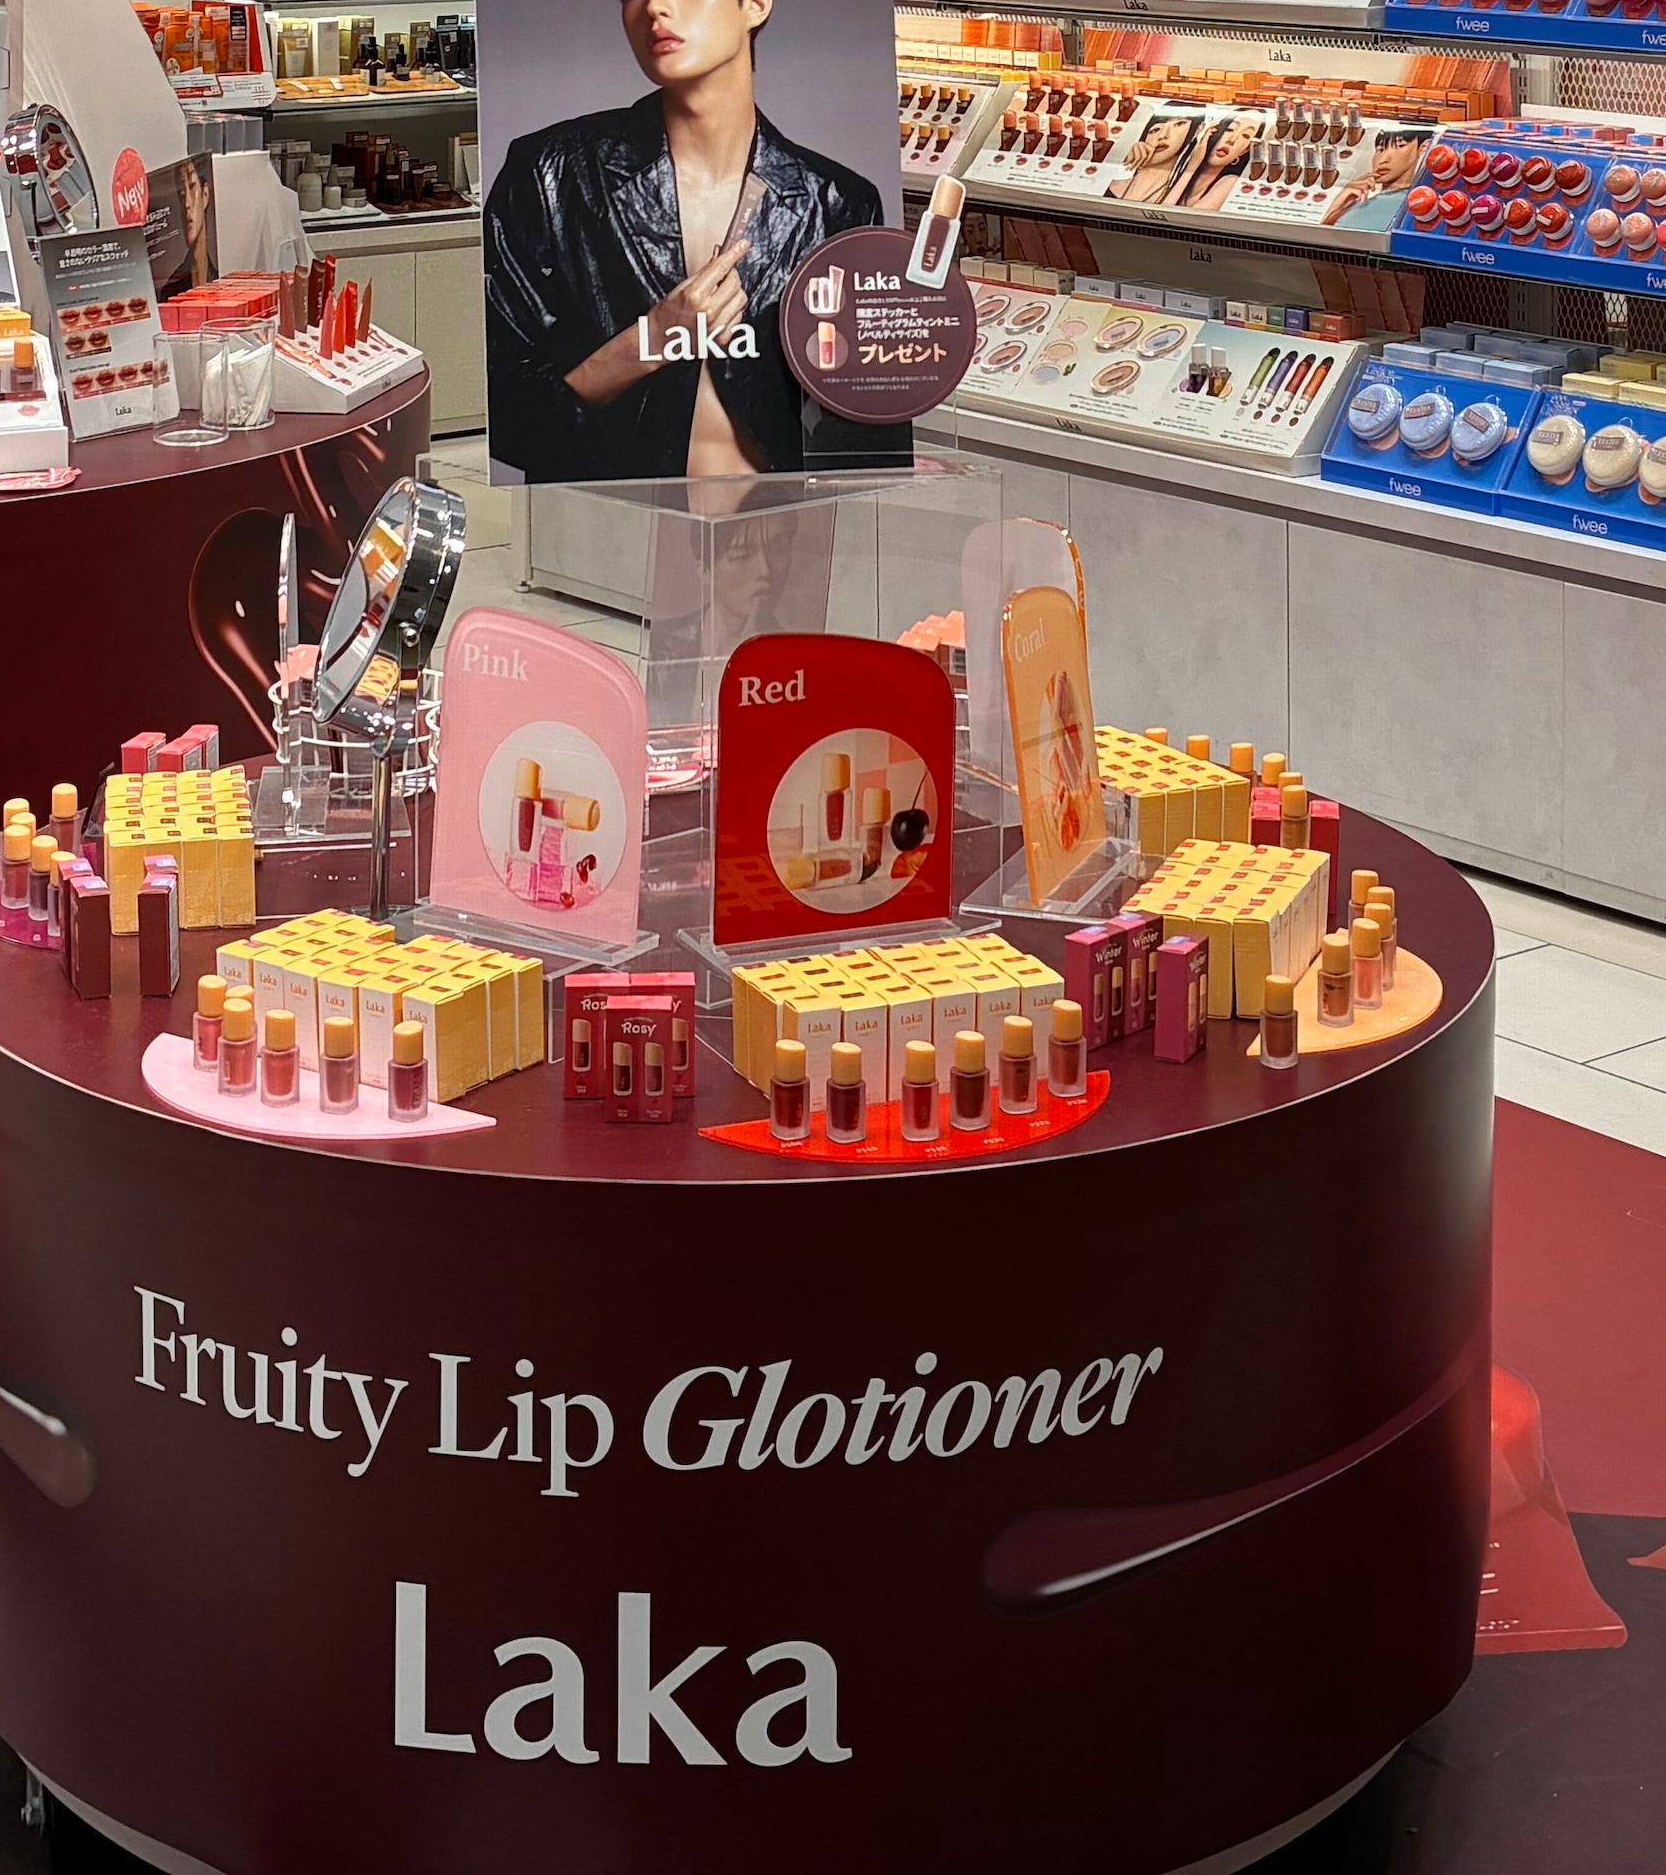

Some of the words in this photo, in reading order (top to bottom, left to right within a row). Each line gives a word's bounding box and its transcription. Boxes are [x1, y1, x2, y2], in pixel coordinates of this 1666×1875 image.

[1456, 17, 1491, 34] fwee
[1268, 49, 1291, 62] Laka
[117, 177, 145, 219] New
[1190, 248, 1212, 262] Laka
[1461, 248, 1495, 266] fwee
[854, 271, 901, 291] Laka
[636, 311, 759, 363] Laka
[858, 343, 947, 365] プレゼント
[1389, 476, 1422, 497] fwee
[1572, 515, 1608, 535] fwee
[1013, 621, 1047, 664] Coral
[461, 643, 529, 683] Pink
[737, 669, 806, 707] Red
[1133, 930, 1160, 949] Winter
[1095, 945, 1123, 965] Winter
[581, 998, 607, 1012] Ros
[621, 1022, 656, 1038] Rosy
[133, 1285, 408, 1477] Fruity
[428, 1351, 614, 1497] Lip
[642, 1345, 1164, 1472] Glotioner
[395, 1581, 852, 1767] Laka
